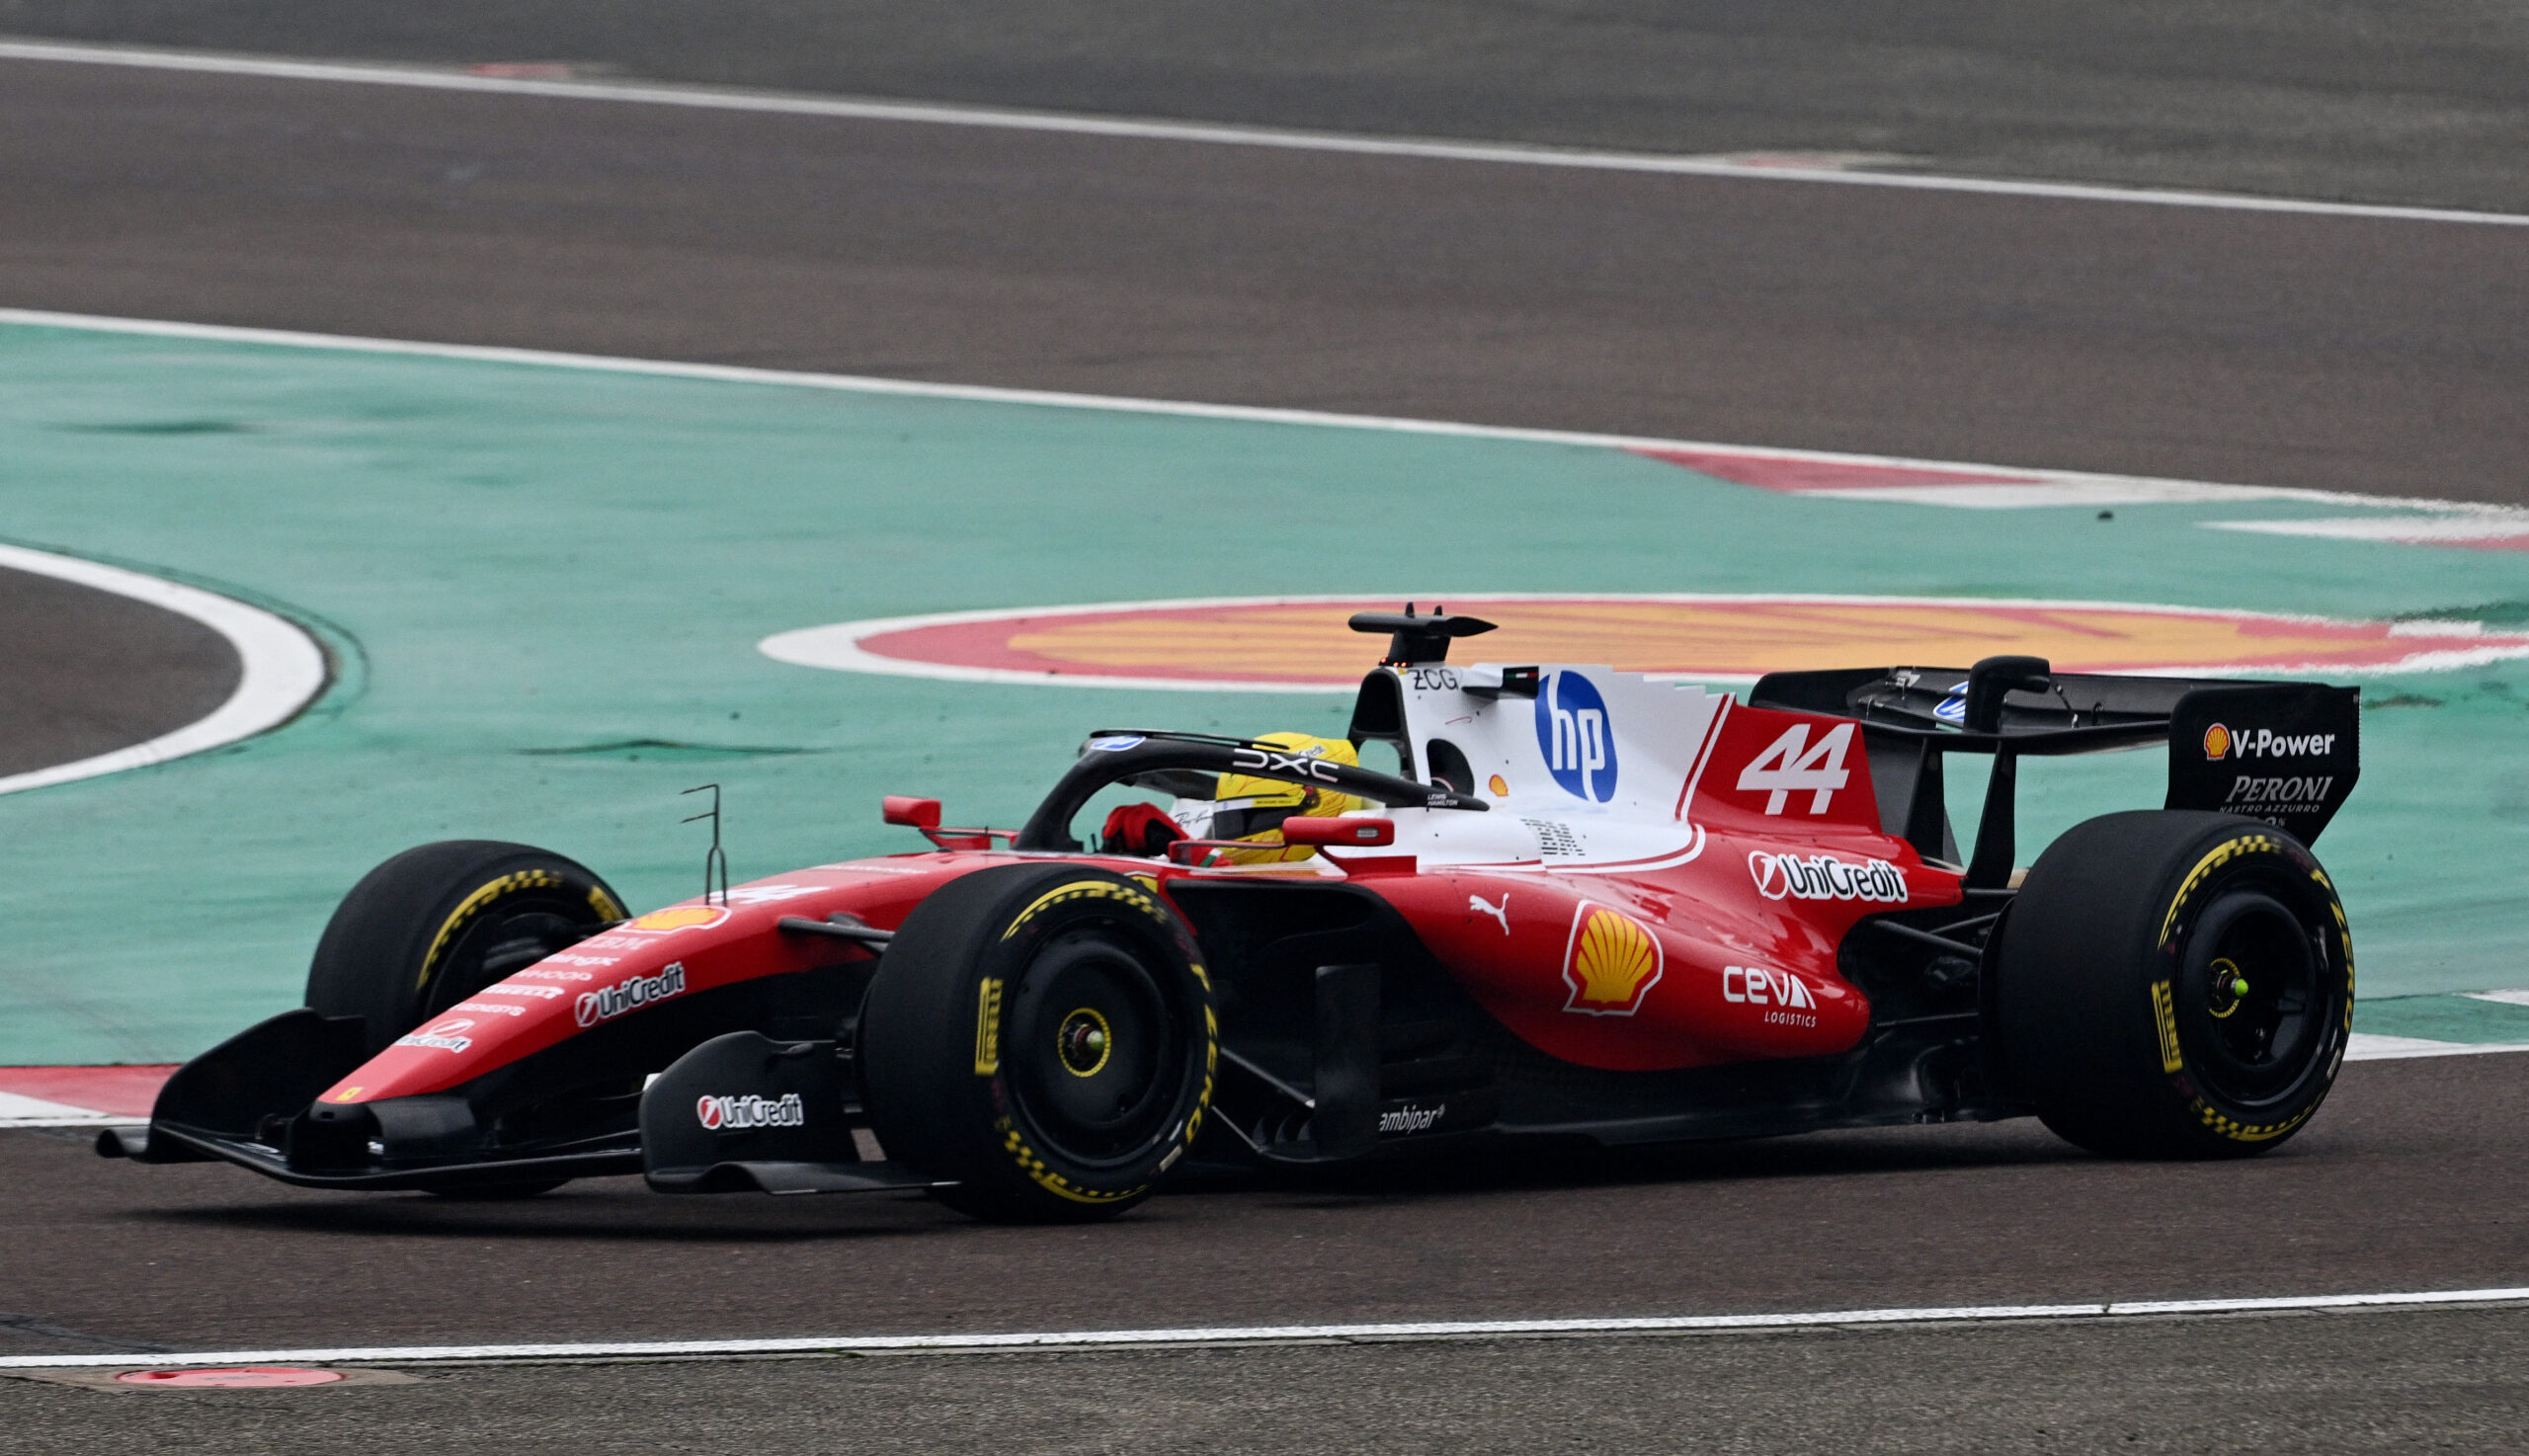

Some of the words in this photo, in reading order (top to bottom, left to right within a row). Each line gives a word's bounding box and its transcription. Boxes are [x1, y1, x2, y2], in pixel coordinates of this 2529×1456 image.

[1547, 671, 1604, 803] hp
[2232, 729, 2334, 759] V-Power
[1232, 748, 1340, 783] DXC
[1736, 723, 1855, 815] 44
[2225, 775, 2333, 803] PERONI
[2219, 804, 2263, 814] NASTRO
[2264, 804, 2320, 814] AZZURRO
[1778, 855, 1908, 902] UniCredit
[599, 961, 685, 1018] UniCredit
[1764, 1011, 1817, 1028] LOGISTICS
[719, 1093, 803, 1127] UniCredit
[1379, 1104, 1438, 1135] ambipar
